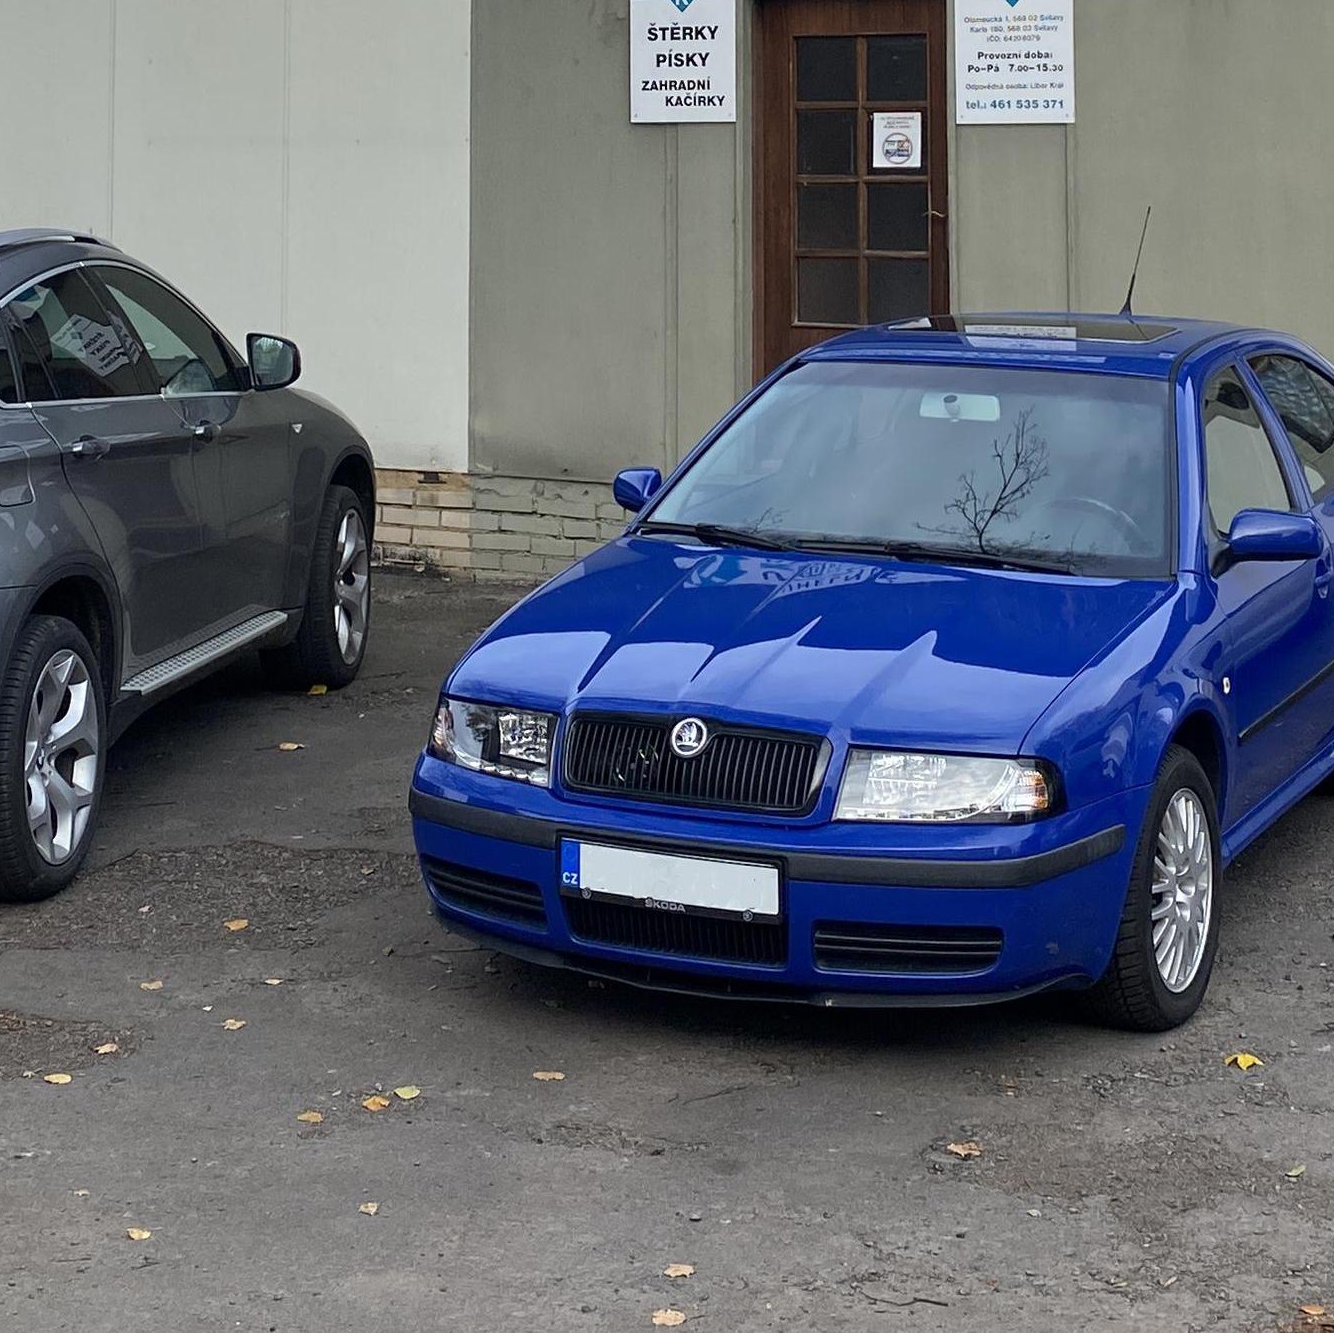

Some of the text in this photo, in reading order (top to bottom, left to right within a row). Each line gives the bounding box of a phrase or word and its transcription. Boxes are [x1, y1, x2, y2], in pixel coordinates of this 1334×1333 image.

[647, 22, 718, 42] ŠTĚRKY
[655, 49, 710, 68] PÍSKY
[977, 51, 1021, 60] Provozní
[641, 76, 711, 91] ZAHRADNÍ
[665, 92, 726, 107] KAČÍRKY
[990, 99, 1012, 109] 461
[1015, 99, 1039, 109] 535
[1042, 99, 1064, 109] 371
[562, 871, 578, 885] CZ
[644, 897, 686, 913] ŠKODA
